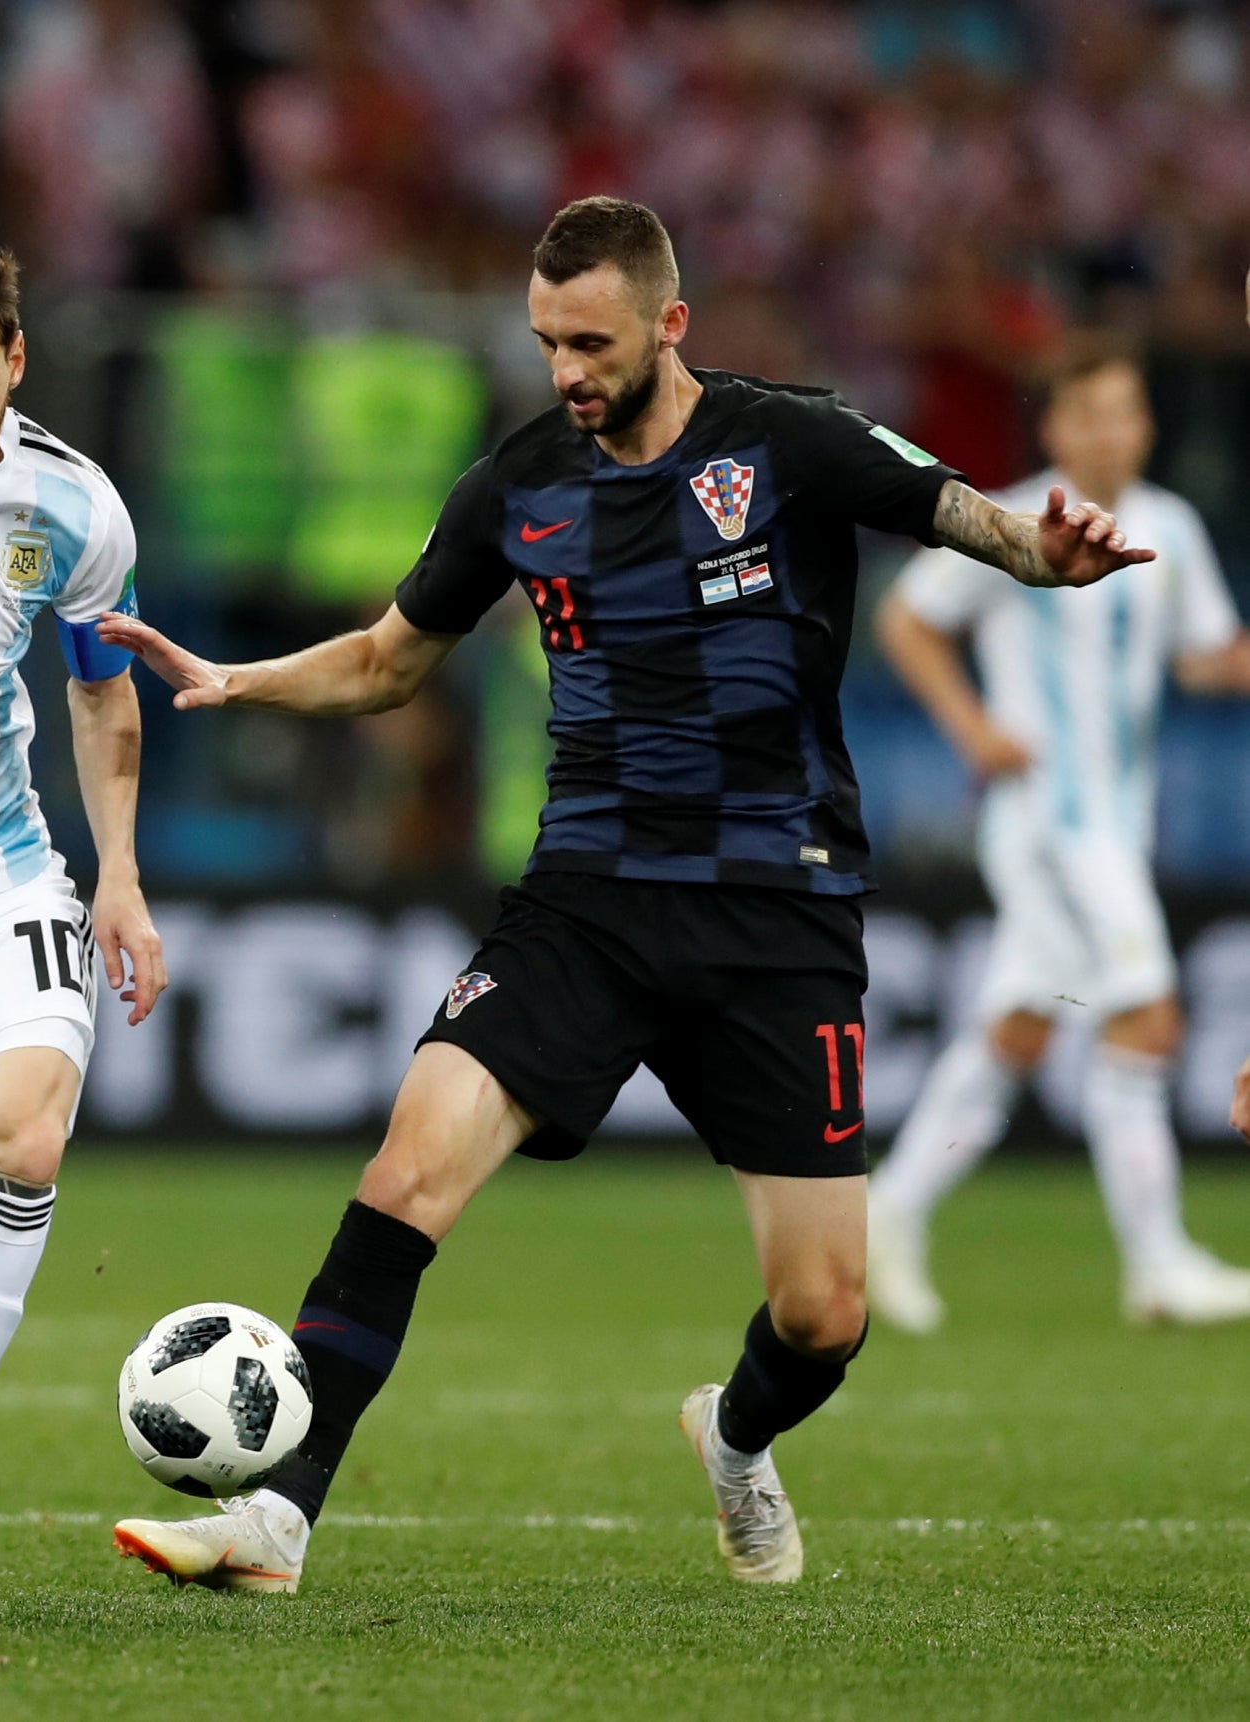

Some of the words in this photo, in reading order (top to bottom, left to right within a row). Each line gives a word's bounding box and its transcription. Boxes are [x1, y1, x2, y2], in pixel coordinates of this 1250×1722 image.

[10, 545, 37, 575] AFA
[530, 577, 584, 652] 11
[13, 918, 83, 992] 10
[815, 1023, 864, 1111] 11
